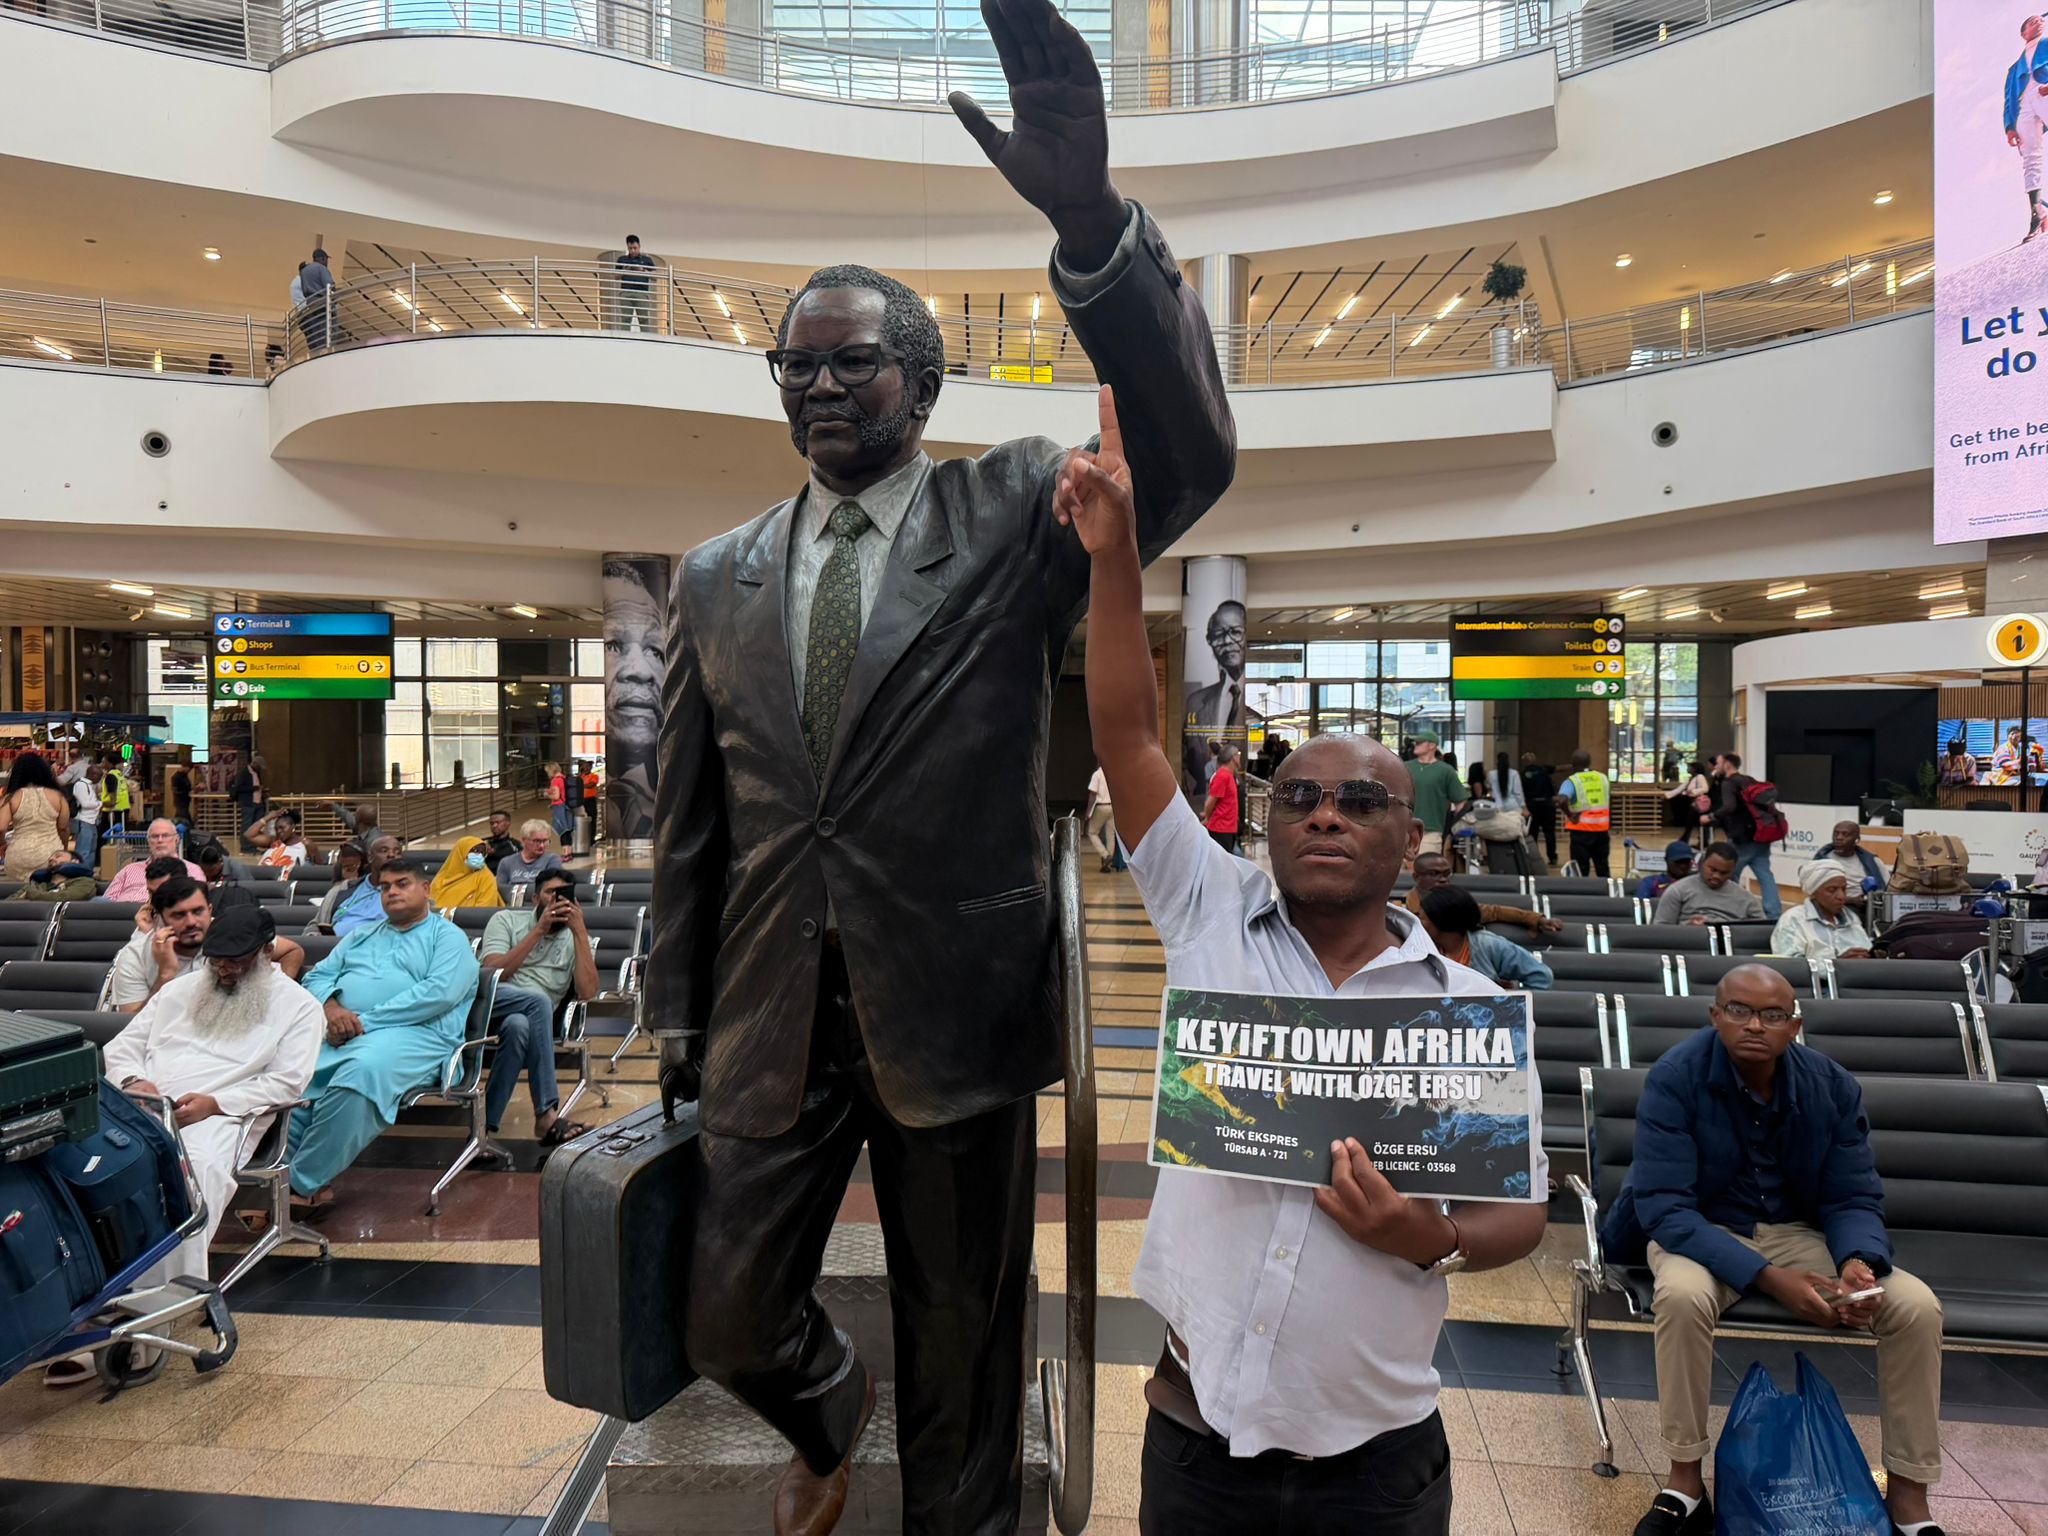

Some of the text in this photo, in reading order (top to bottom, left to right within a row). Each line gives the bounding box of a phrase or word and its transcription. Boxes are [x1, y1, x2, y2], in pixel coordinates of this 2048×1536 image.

[1961, 307, 2024, 345] Let
[1986, 347, 2037, 379] do
[1950, 431, 1983, 448] Get
[1988, 427, 2020, 442] the
[1964, 450, 2009, 466] from
[248, 619, 290, 629] Terminal B
[1456, 622, 1502, 631] International
[1503, 622, 1527, 631] Indaba
[1528, 621, 1568, 630] Conference
[249, 641, 273, 650] Shops
[1565, 642, 1592, 651] Toilets
[250, 661, 300, 671] Bus Terminal
[249, 684, 265, 693] Exit
[1576, 684, 1592, 693] Exit
[1203, 1061, 1482, 1100] TRAVEL WITH ÖZGE ERSU
[1215, 1126, 1299, 1148] TÜRK EKSPRES
[1224, 1142, 1288, 1160] TÜRSAB A 721
[1374, 1142, 1438, 1156] ÖZGE ERSU
[1385, 1161, 1420, 1171] LICENCE
[1427, 1163, 1456, 1173] 03568
